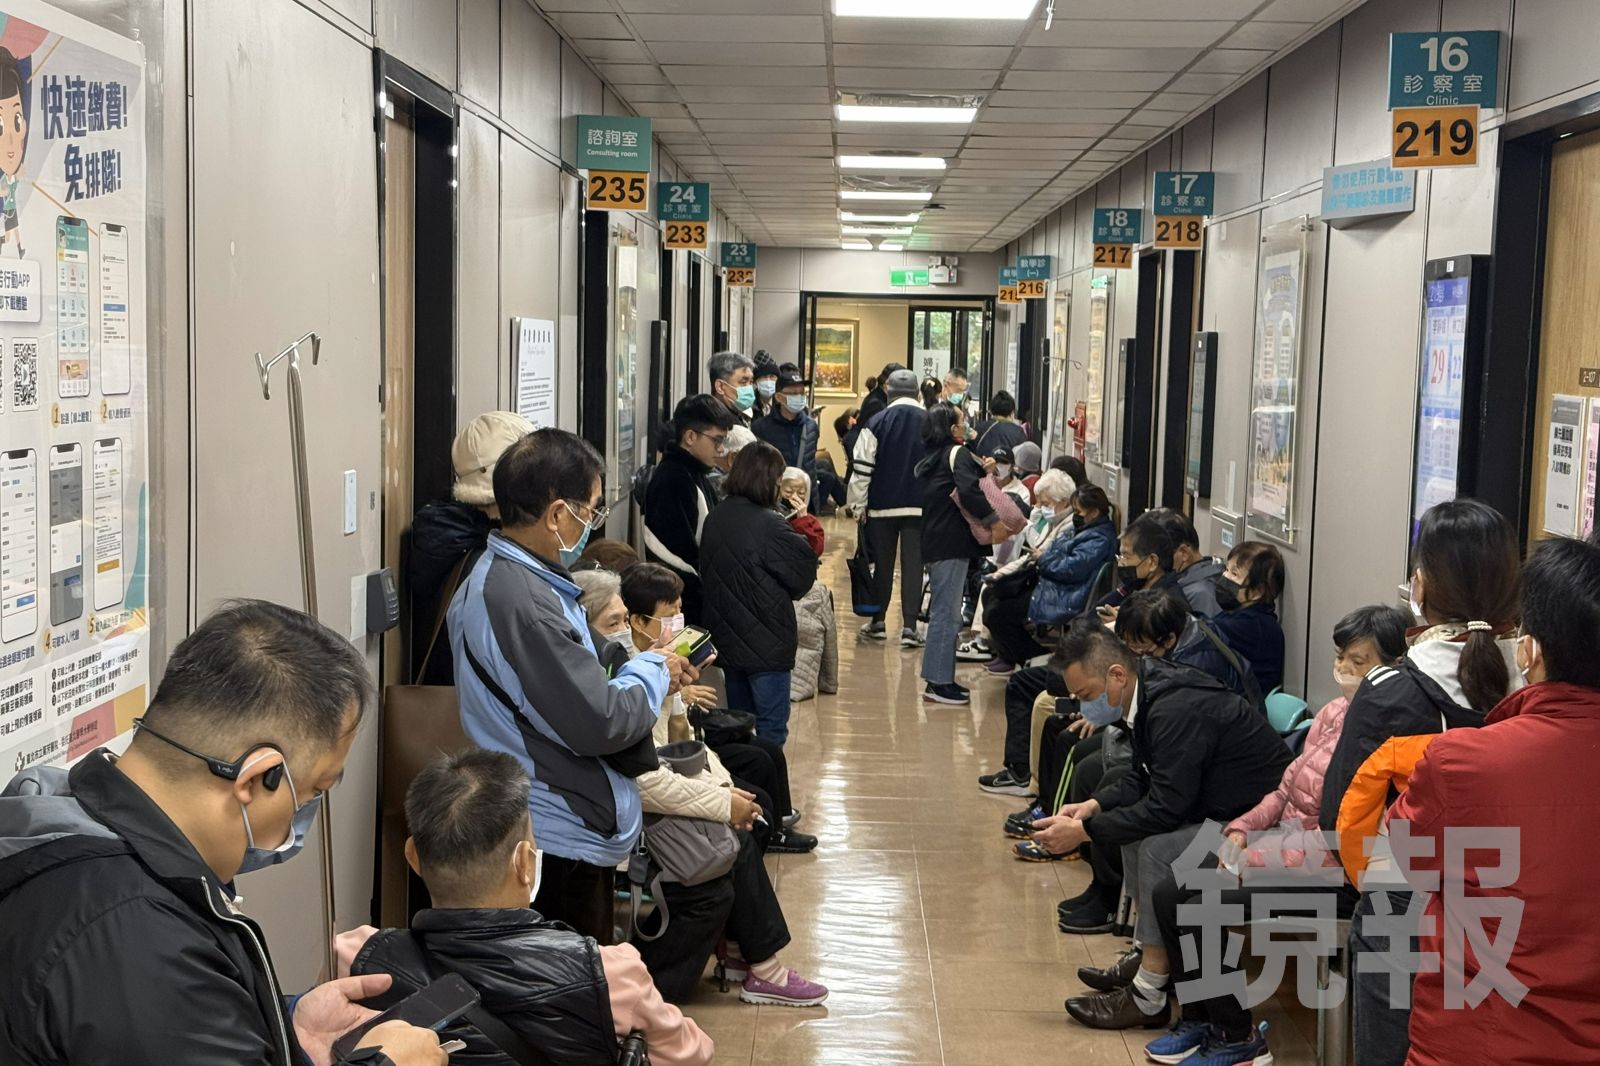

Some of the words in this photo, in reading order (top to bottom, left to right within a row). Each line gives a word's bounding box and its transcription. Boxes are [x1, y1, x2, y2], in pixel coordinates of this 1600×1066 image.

[1420, 36, 1469, 72] 16
[1403, 74, 1483, 94] 診察室
[1426, 95, 1459, 106] Clinic
[587, 128, 638, 147] 諮詢室
[1394, 118, 1474, 158] 219
[586, 149, 620, 158] Consulting
[621, 150, 638, 158] room
[589, 175, 645, 203] 235
[1170, 174, 1199, 195] 17
[670, 186, 696, 203] 24
[1160, 195, 1206, 207] 診察室
[663, 204, 702, 214] 診察室
[1105, 210, 1128, 227] 18
[666, 225, 706, 243] 233
[1156, 221, 1200, 242] 218
[730, 244, 748, 256] 23
[1095, 246, 1131, 263] 217
[728, 270, 754, 283] 232
[1018, 282, 1044, 294] 216
[1430, 349, 1445, 384] 29
